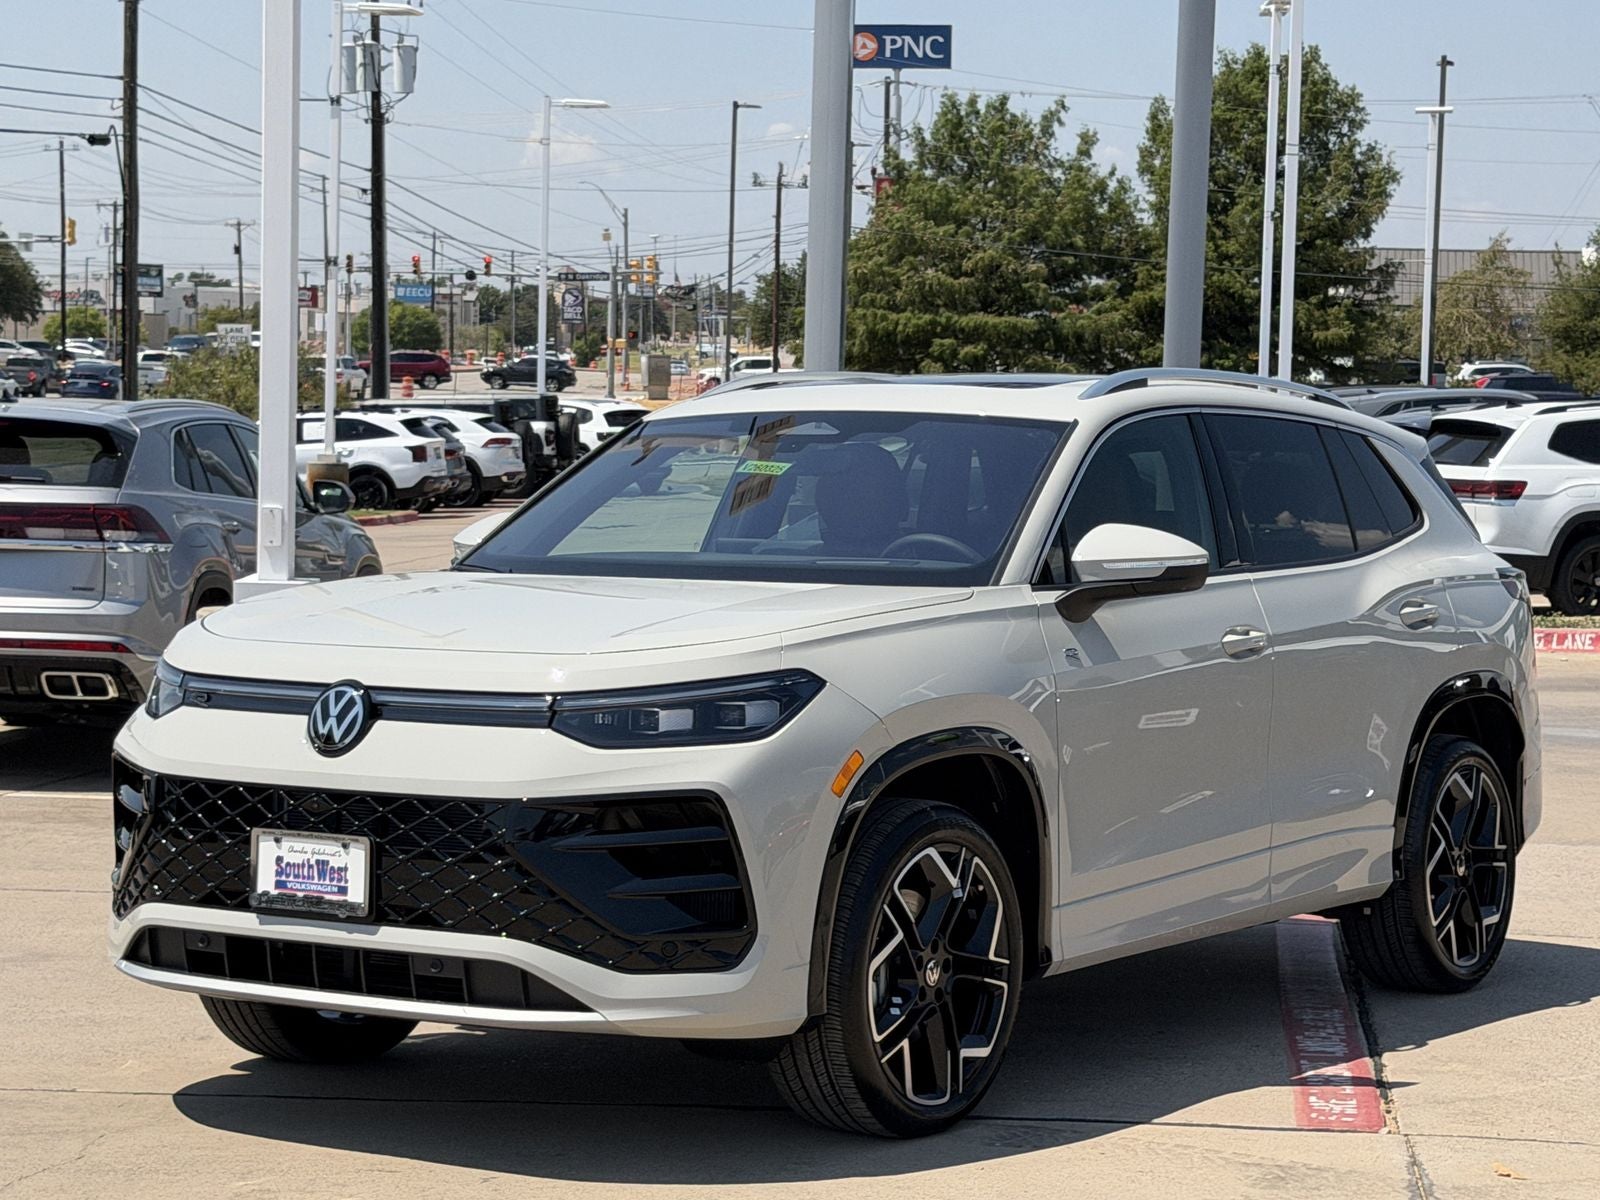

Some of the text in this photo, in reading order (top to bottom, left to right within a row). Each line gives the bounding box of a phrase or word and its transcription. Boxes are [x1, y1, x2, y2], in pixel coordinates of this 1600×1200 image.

[881, 35, 945, 59] PNC
[406, 287, 432, 297] EECU
[563, 312, 583, 320] BELL
[1551, 632, 1596, 650] LANE
[274, 855, 349, 885] SouthWest
[286, 881, 339, 893] VOLKSWAGEN
